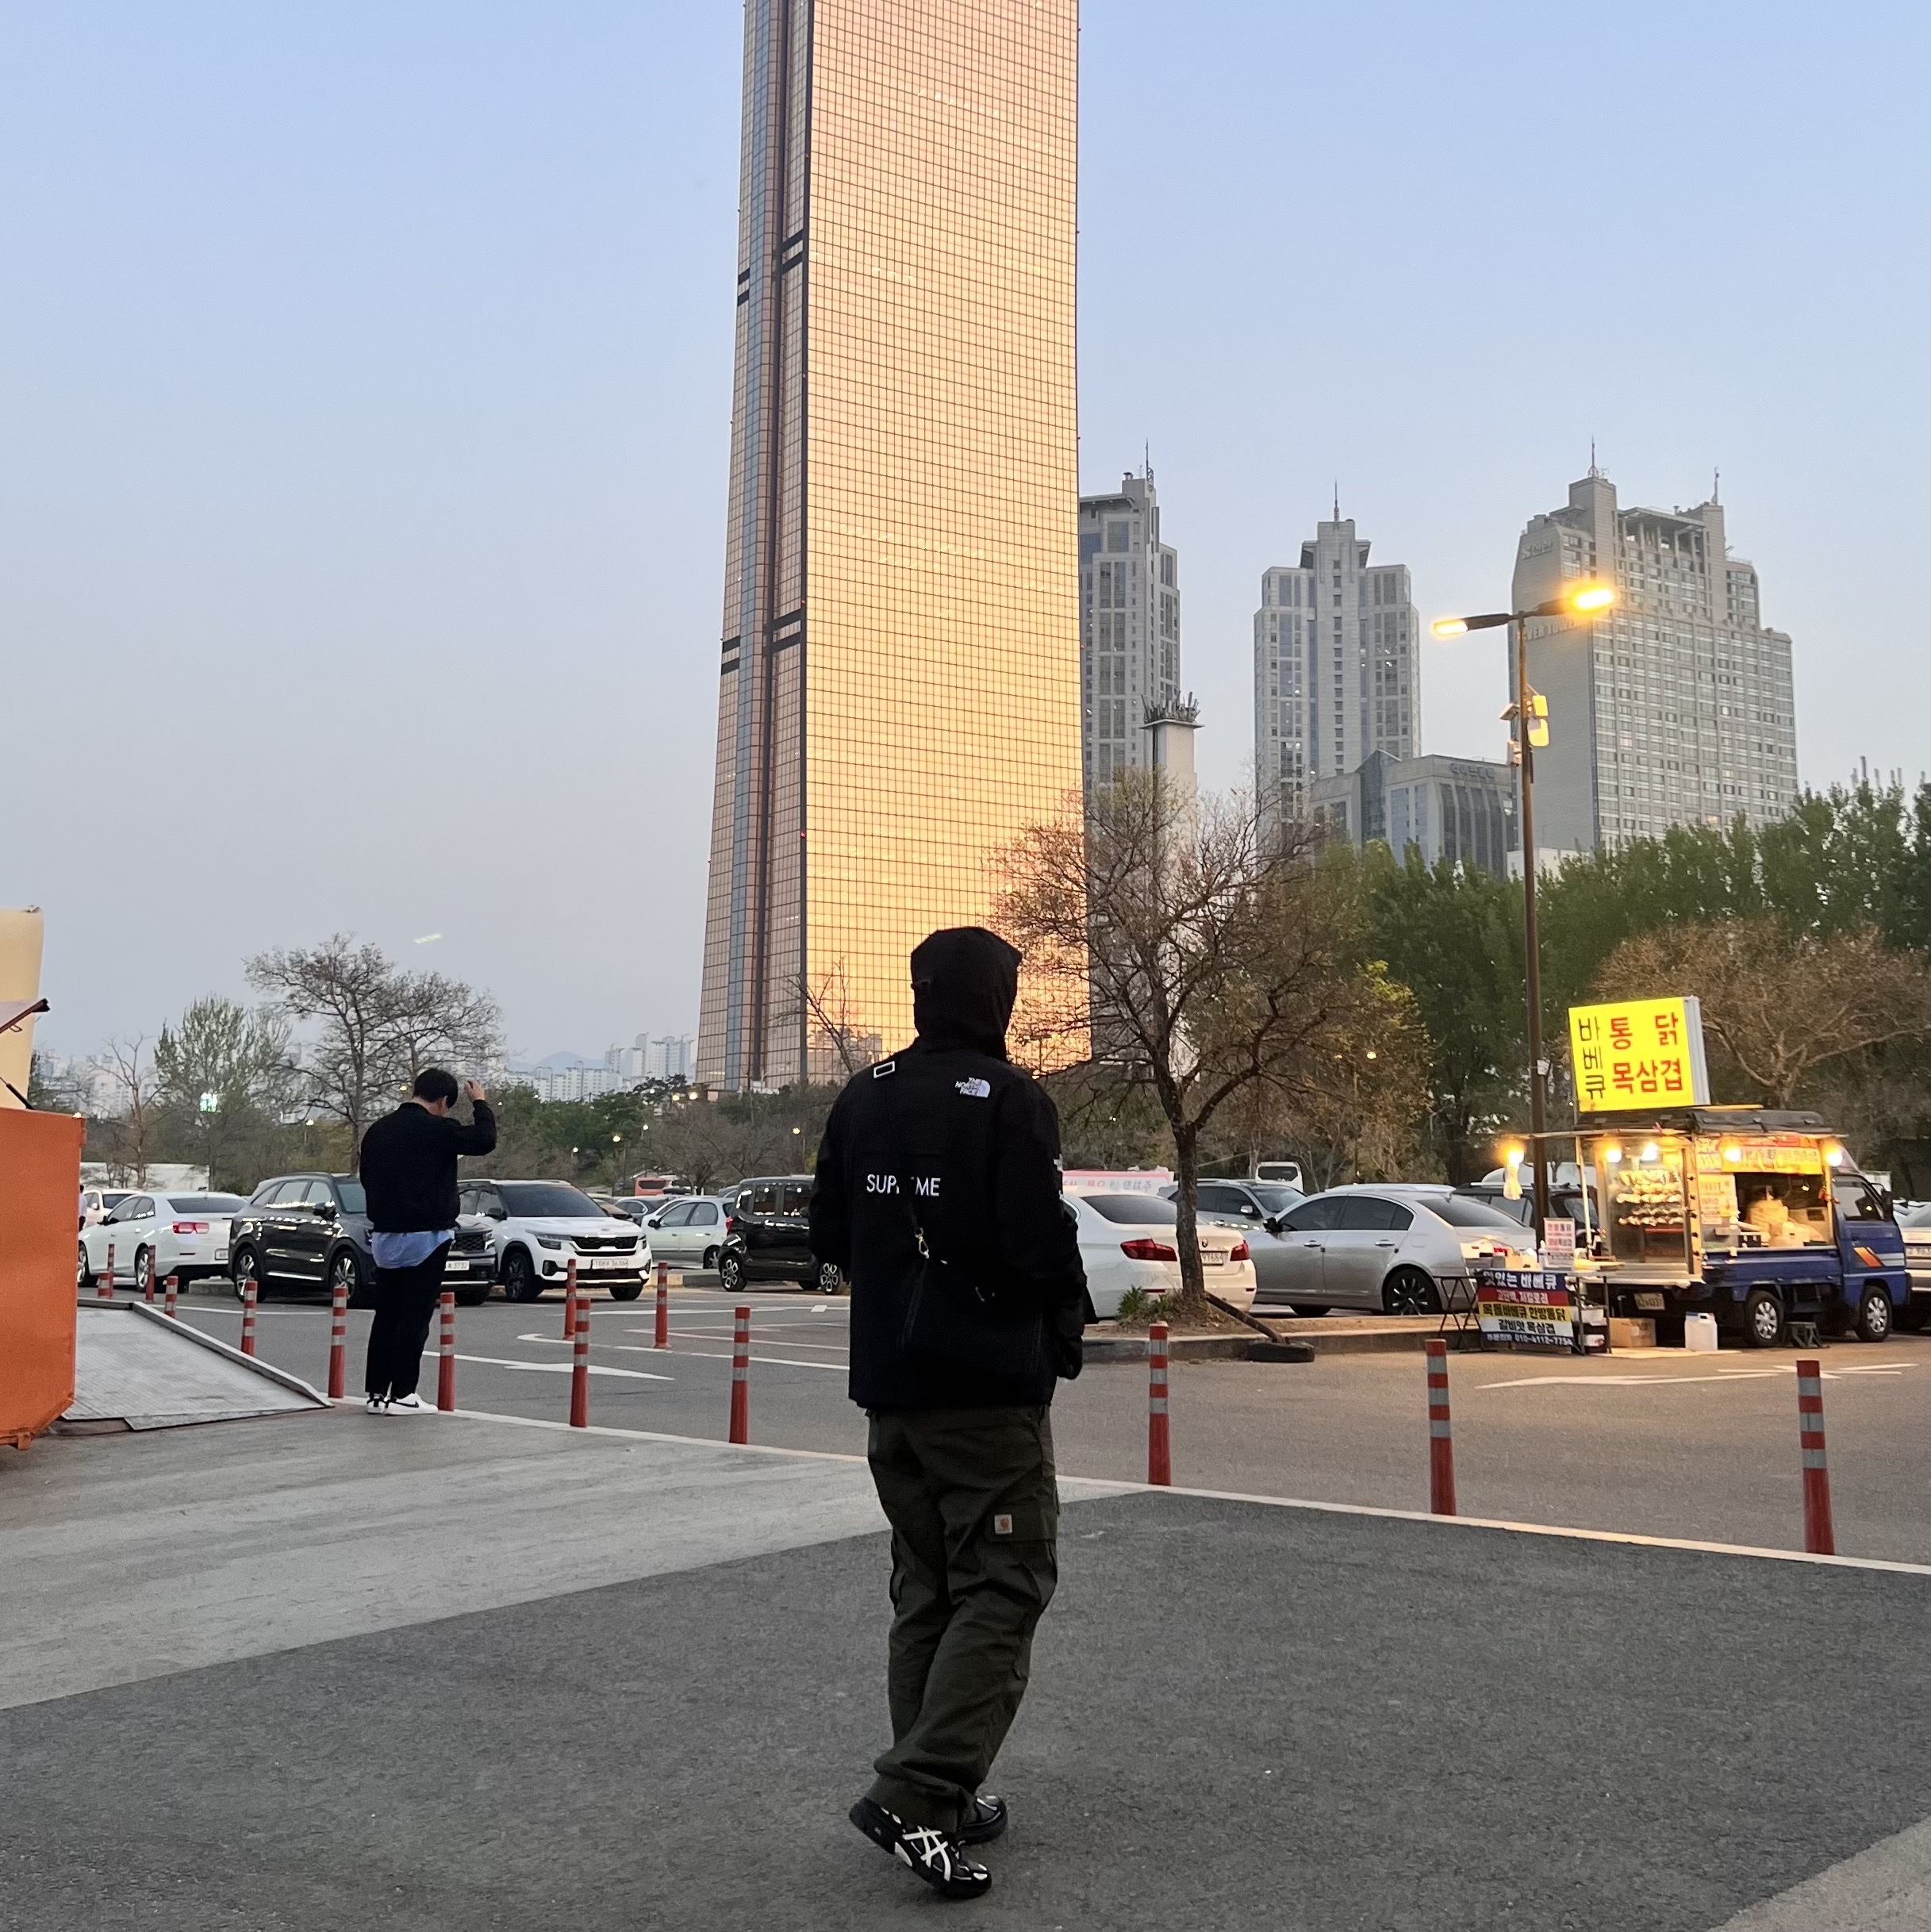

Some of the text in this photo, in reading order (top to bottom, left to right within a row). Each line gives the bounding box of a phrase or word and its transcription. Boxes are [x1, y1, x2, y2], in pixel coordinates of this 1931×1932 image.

[1578, 1016, 1607, 1100] 바베큐
[1611, 1057, 1683, 1094] 목삼겹
[866, 1173, 942, 1196] SUPME
[1482, 1270, 1557, 1290] 맛있는 바베큐
